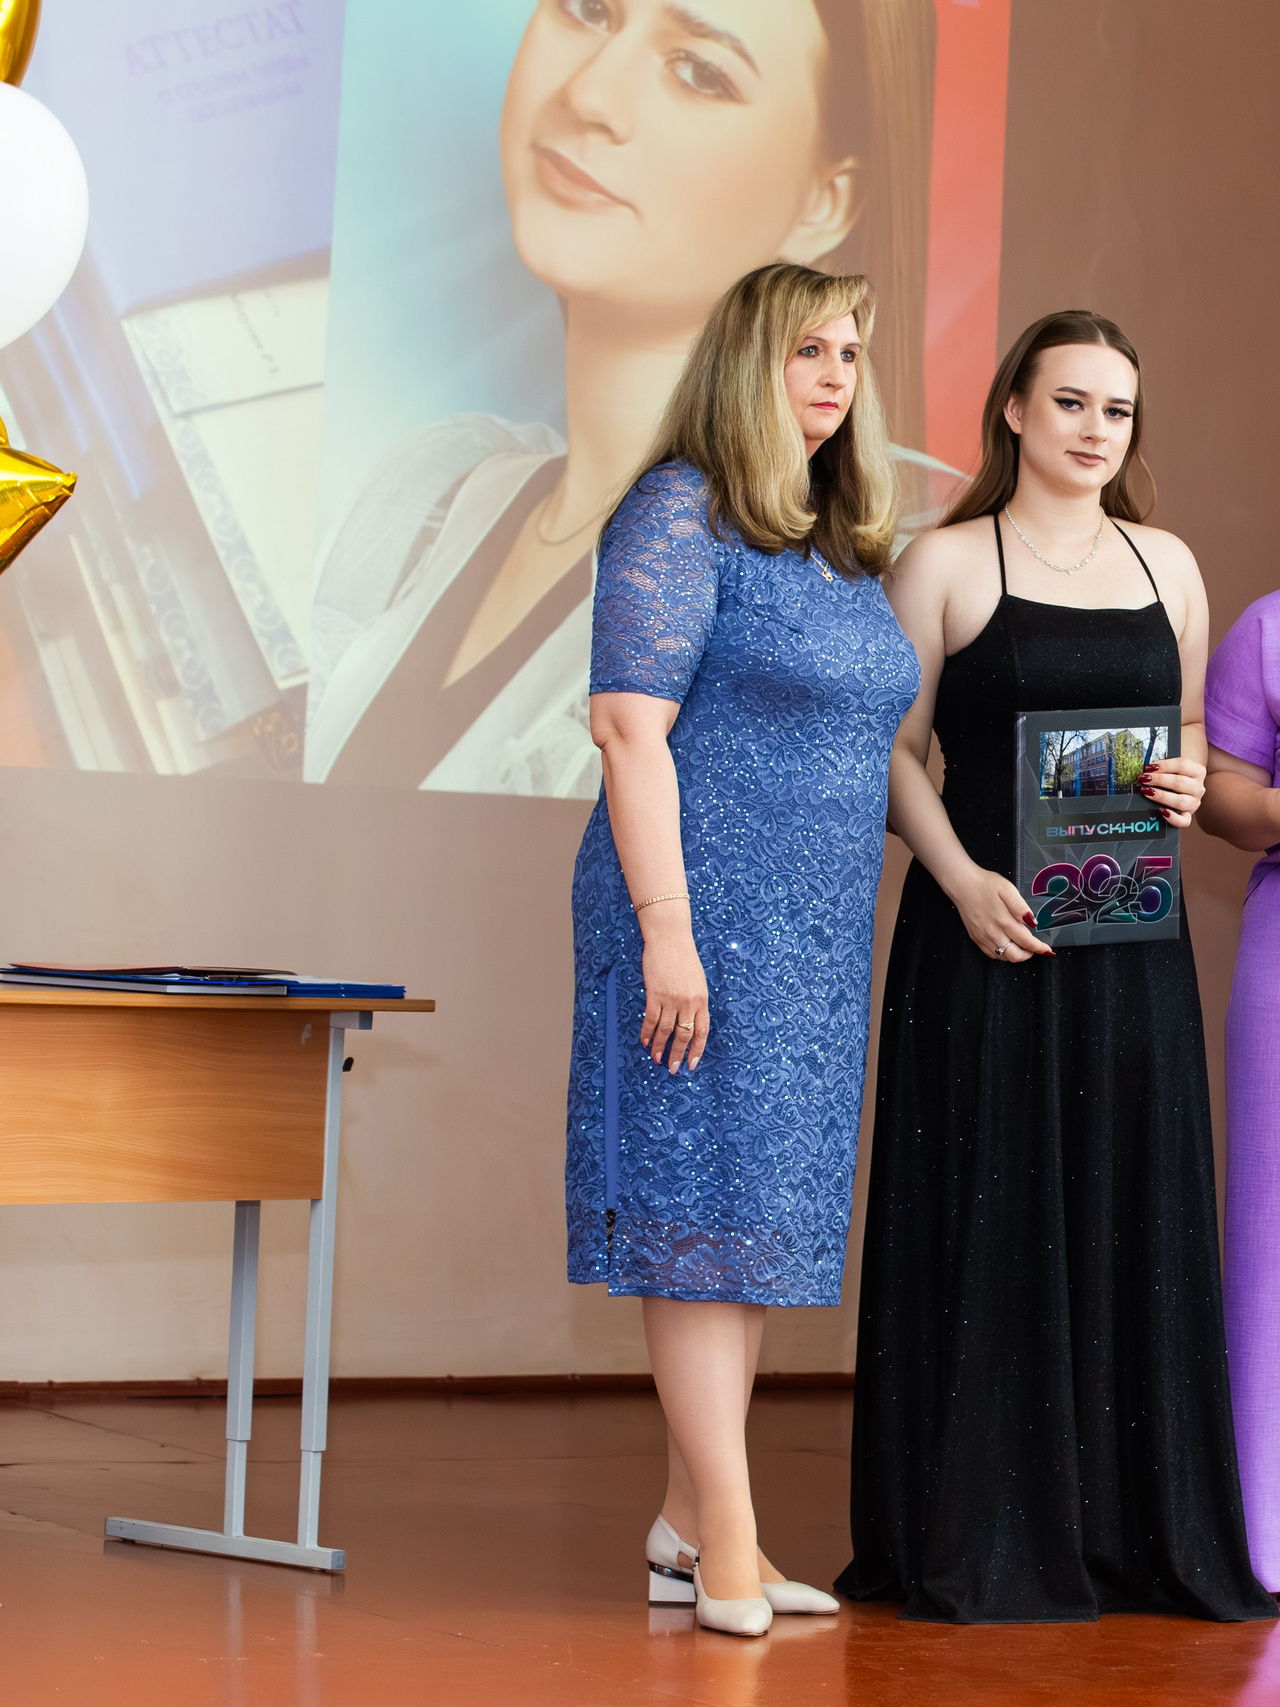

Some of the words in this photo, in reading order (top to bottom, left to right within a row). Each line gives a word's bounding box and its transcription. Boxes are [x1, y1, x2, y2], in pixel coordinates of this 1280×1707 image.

[124, 0, 305, 77] АТТЕСТАТ
[1046, 817, 1160, 838] ВЫПУСКНОЙ
[1032, 854, 1173, 932] 2025
